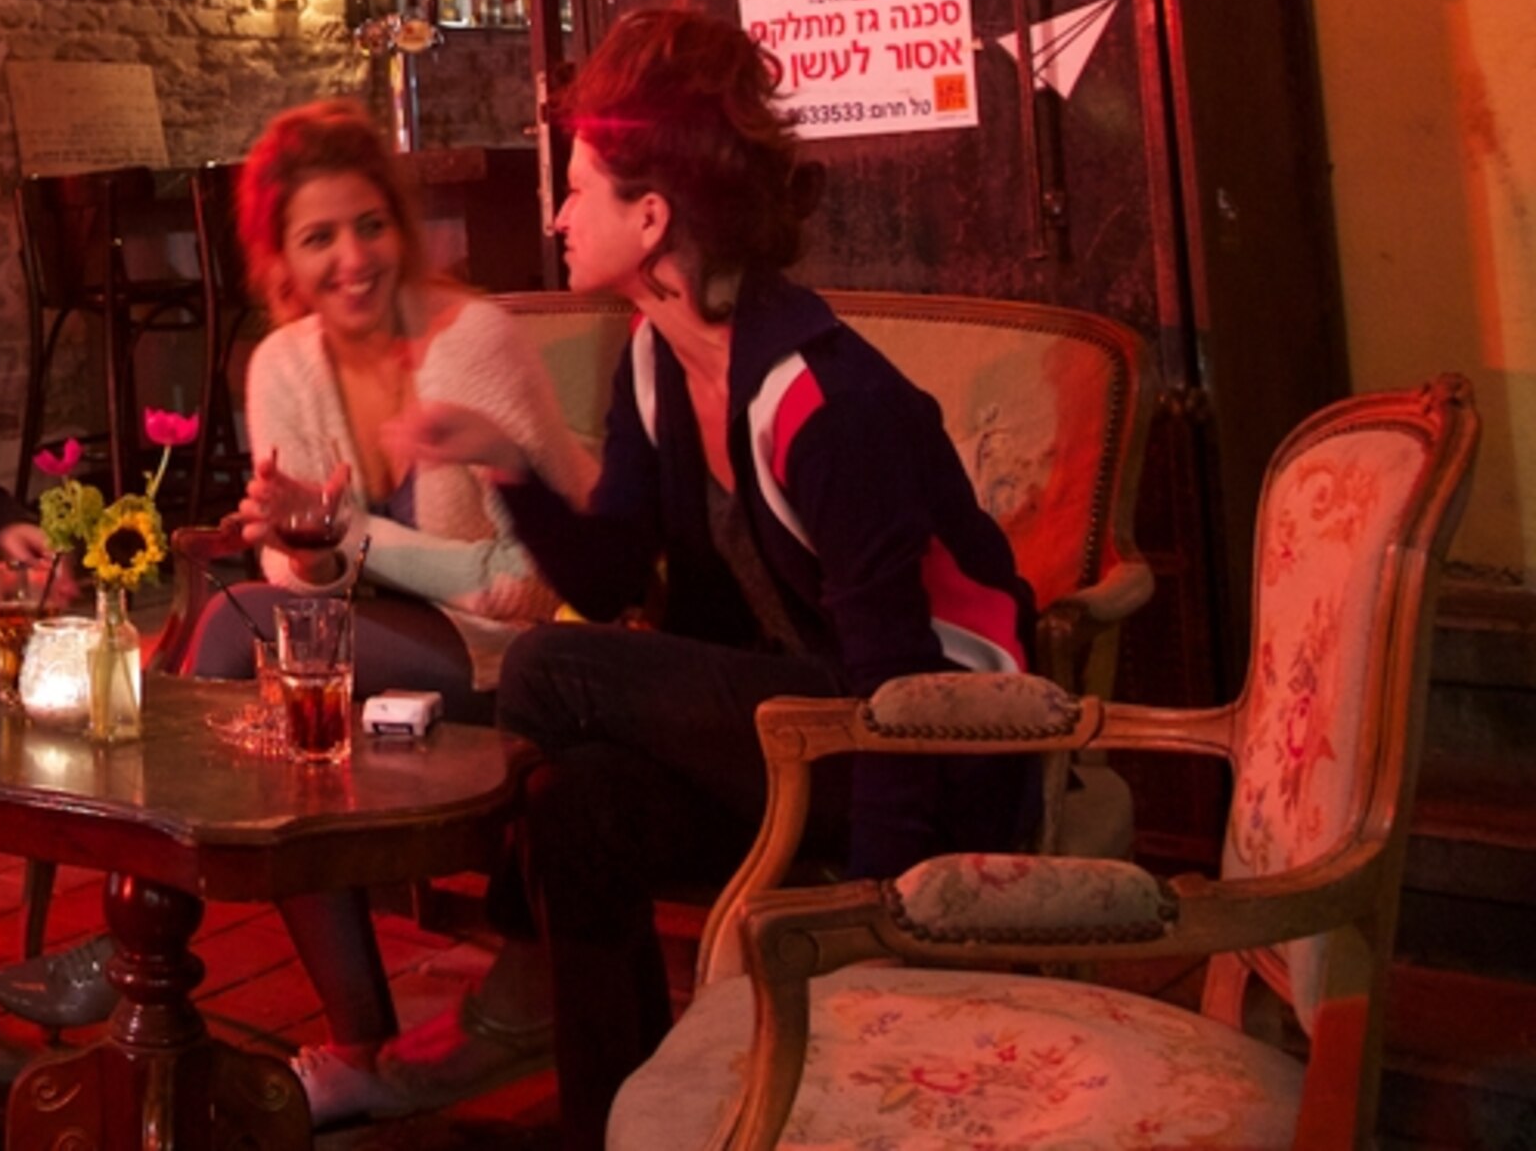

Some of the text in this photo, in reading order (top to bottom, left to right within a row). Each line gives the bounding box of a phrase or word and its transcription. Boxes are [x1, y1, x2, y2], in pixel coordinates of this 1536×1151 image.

[854, 8, 880, 33] גז
[890, 0, 962, 31] סכנה
[790, 38, 963, 88] אסור לעשן
